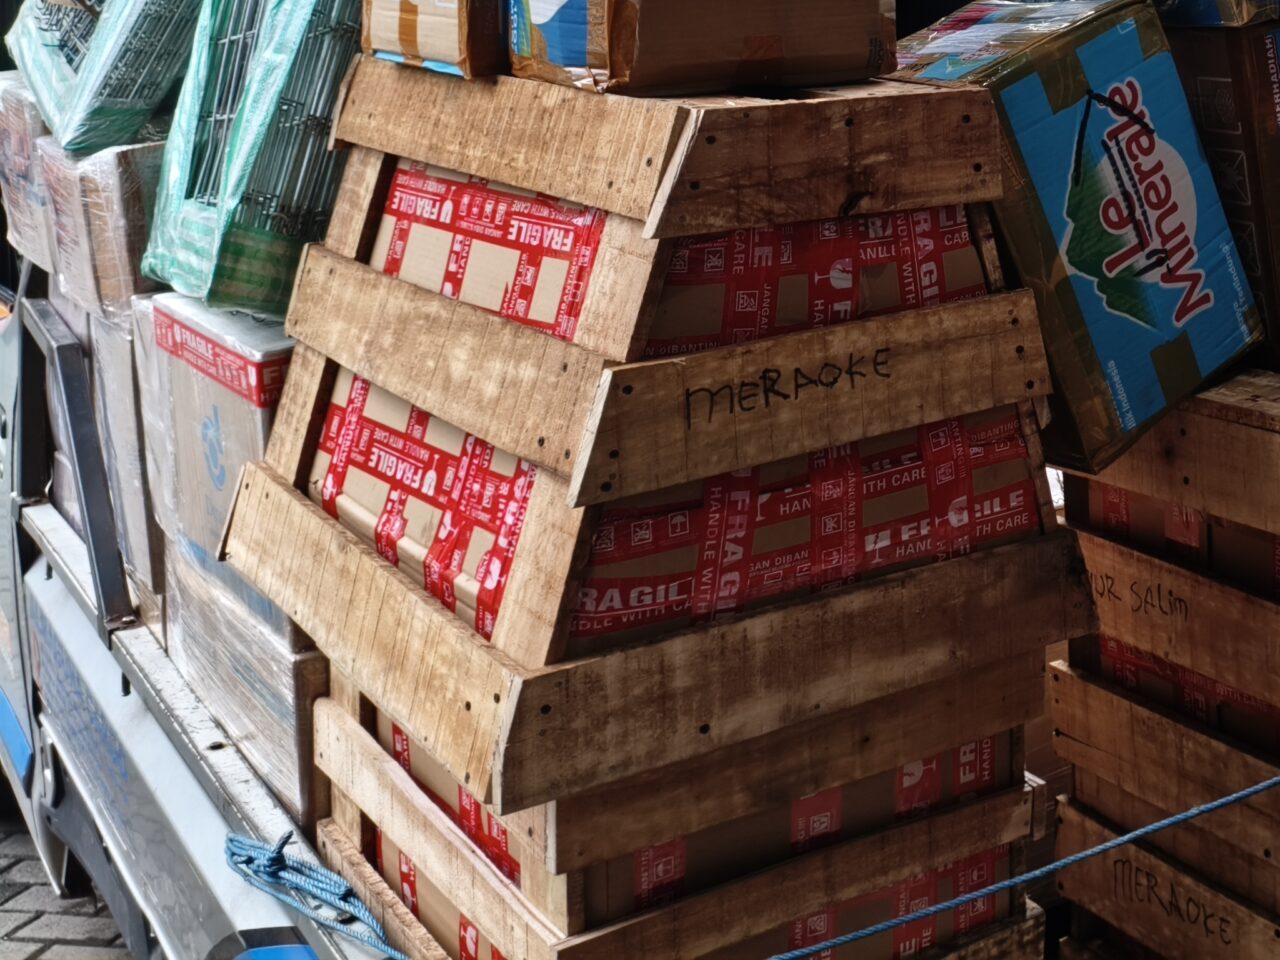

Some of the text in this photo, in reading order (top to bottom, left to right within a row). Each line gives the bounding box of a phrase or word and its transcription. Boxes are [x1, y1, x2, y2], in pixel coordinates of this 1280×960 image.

[391, 190, 441, 221] FRAGILE
[1107, 80, 1212, 327] Minerale
[507, 218, 575, 252] FRAGILE
[896, 214, 911, 257] NDLE
[1100, 193, 1151, 278] Le
[456, 236, 471, 279] HAND
[913, 210, 940, 306] RAGI
[368, 447, 423, 489] FRAGILE
[863, 478, 886, 494] ITH
[996, 514, 1029, 532] CARE
[697, 487, 722, 614] HANDLE WITH
[715, 490, 751, 609] FRAGI
[774, 550, 809, 566] DIBAN
[576, 577, 694, 613] RAGIL
[982, 736, 992, 781] HAND
